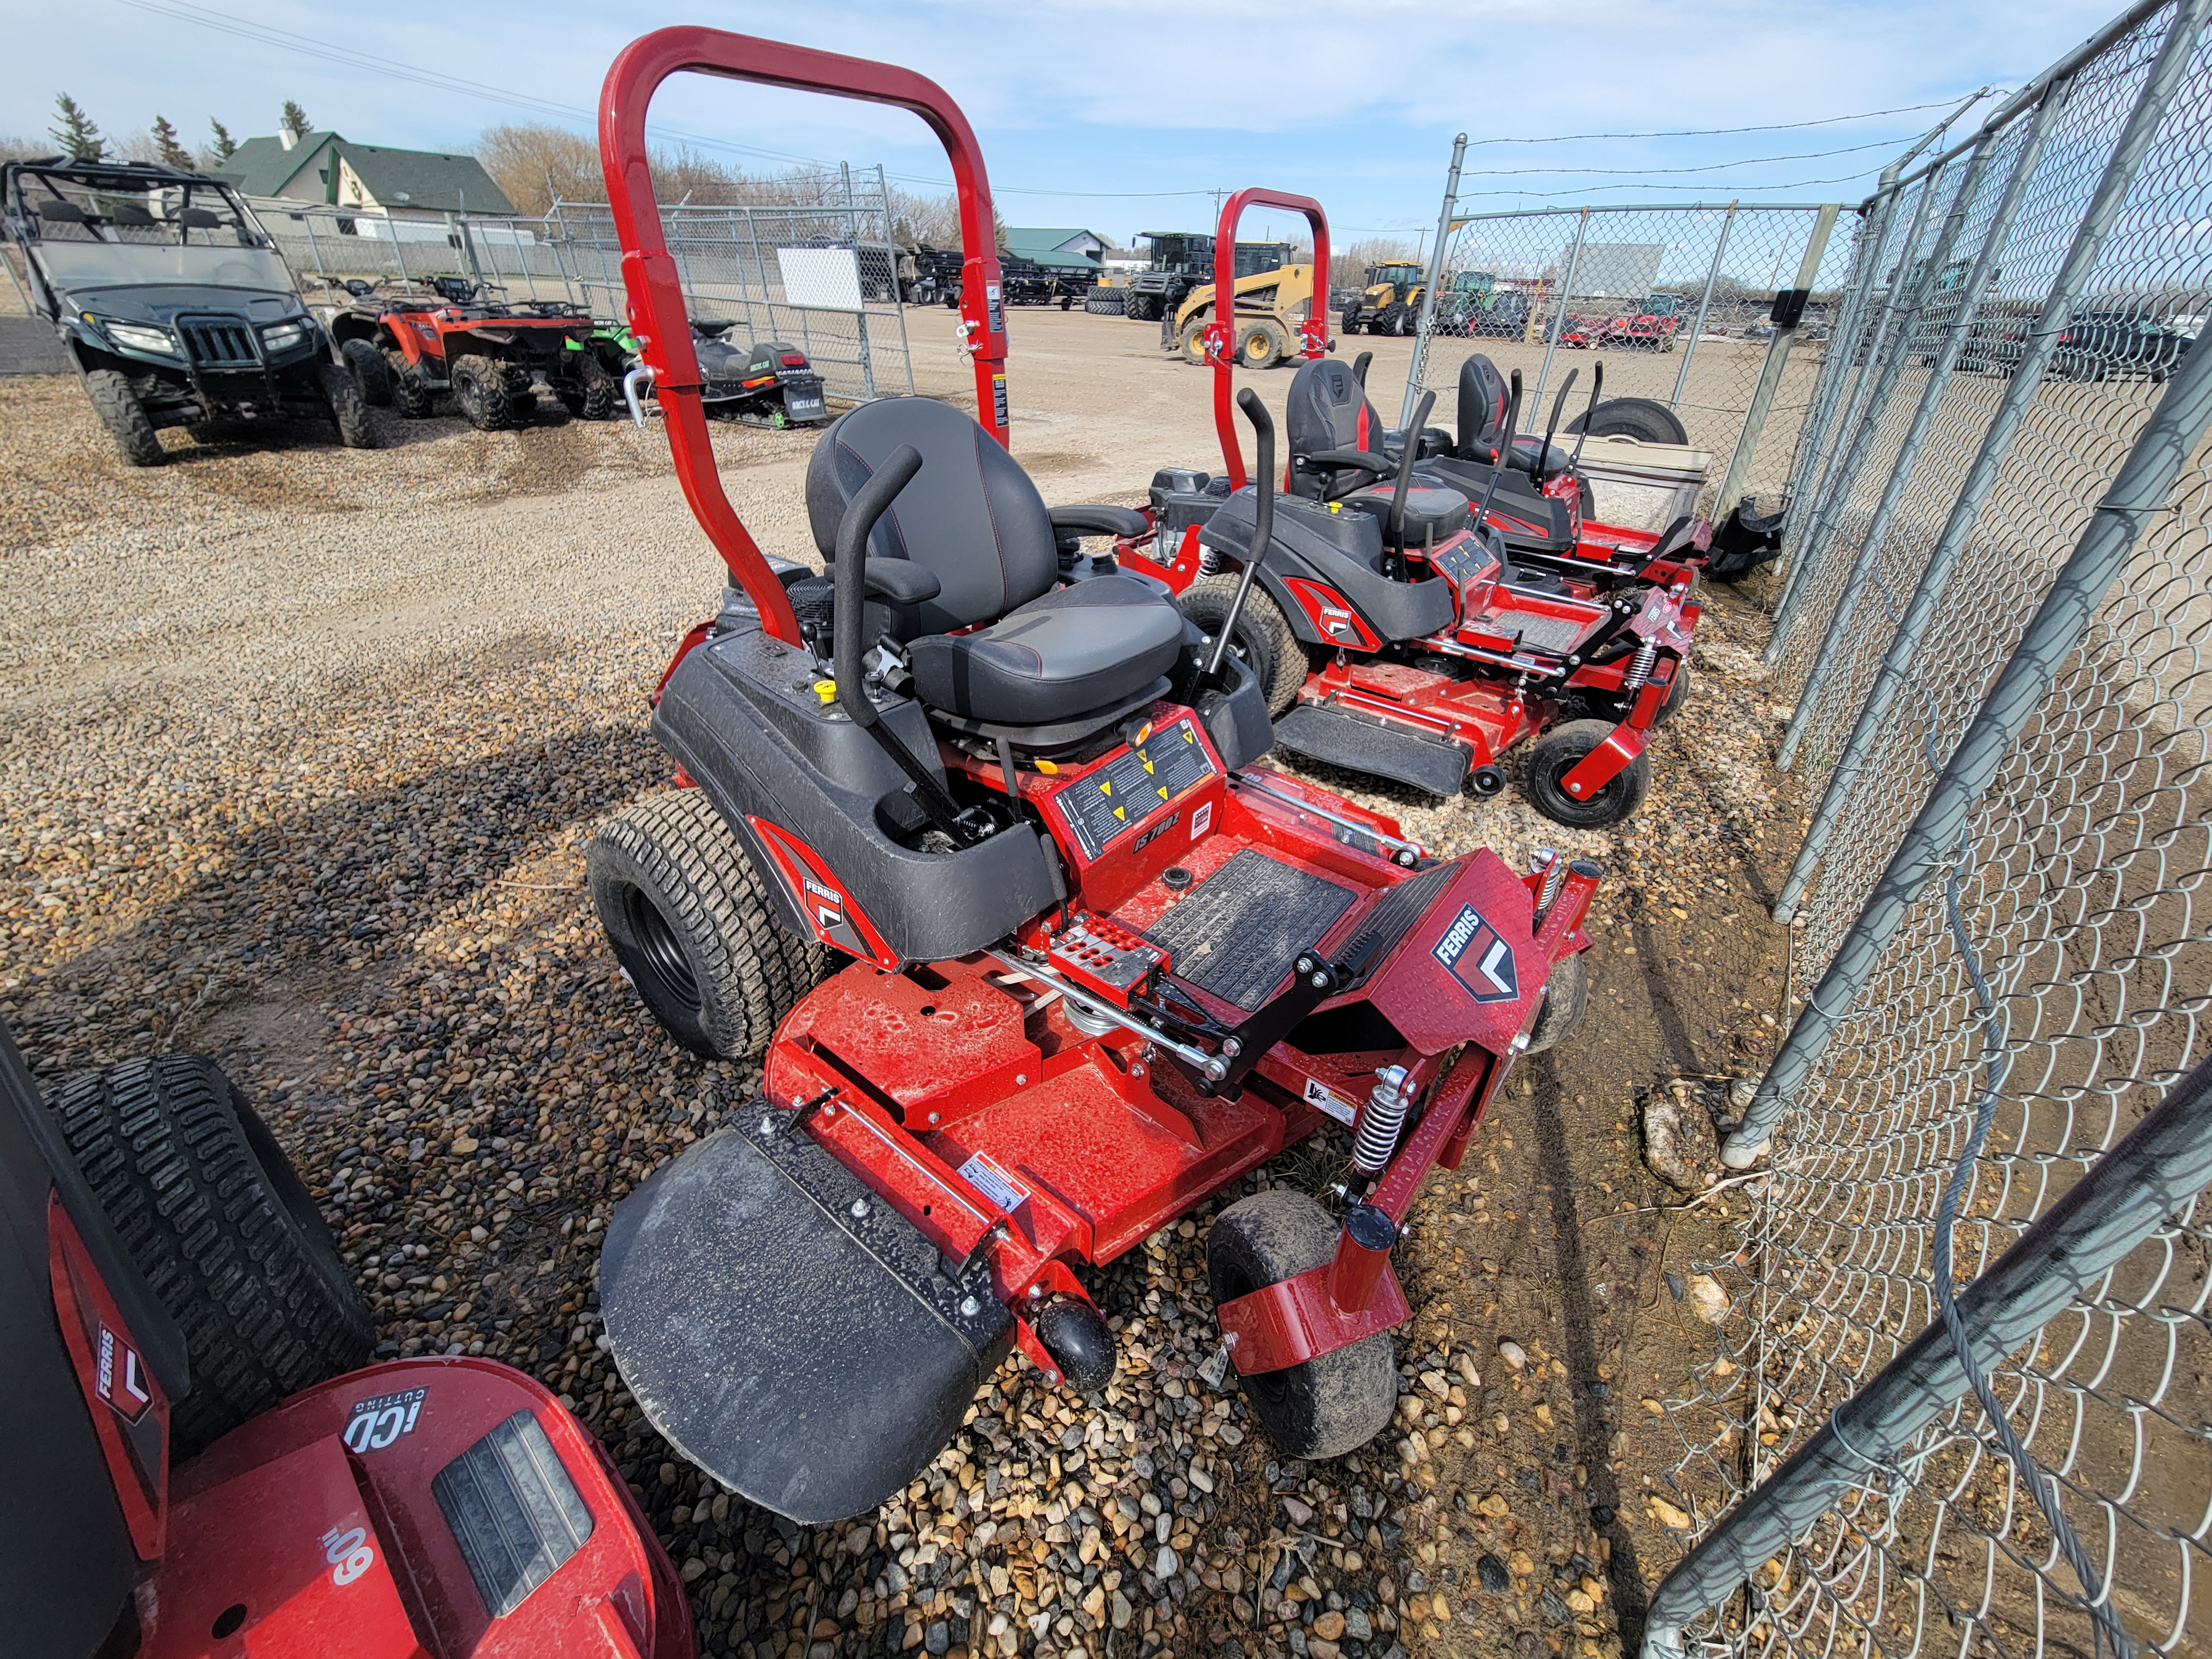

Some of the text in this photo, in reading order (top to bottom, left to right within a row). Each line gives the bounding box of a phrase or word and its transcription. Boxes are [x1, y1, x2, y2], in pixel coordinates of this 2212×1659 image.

[810, 398, 820, 408] CAT
[1324, 608, 1349, 619] FERRIS
[1134, 833, 1149, 853] IS
[1150, 810, 1181, 841] 700Z
[806, 880, 840, 904] FERRIS
[1436, 909, 1480, 966] FERRIS
[99, 1329, 114, 1400] FERRIS
[356, 1389, 425, 1413] CUTTING
